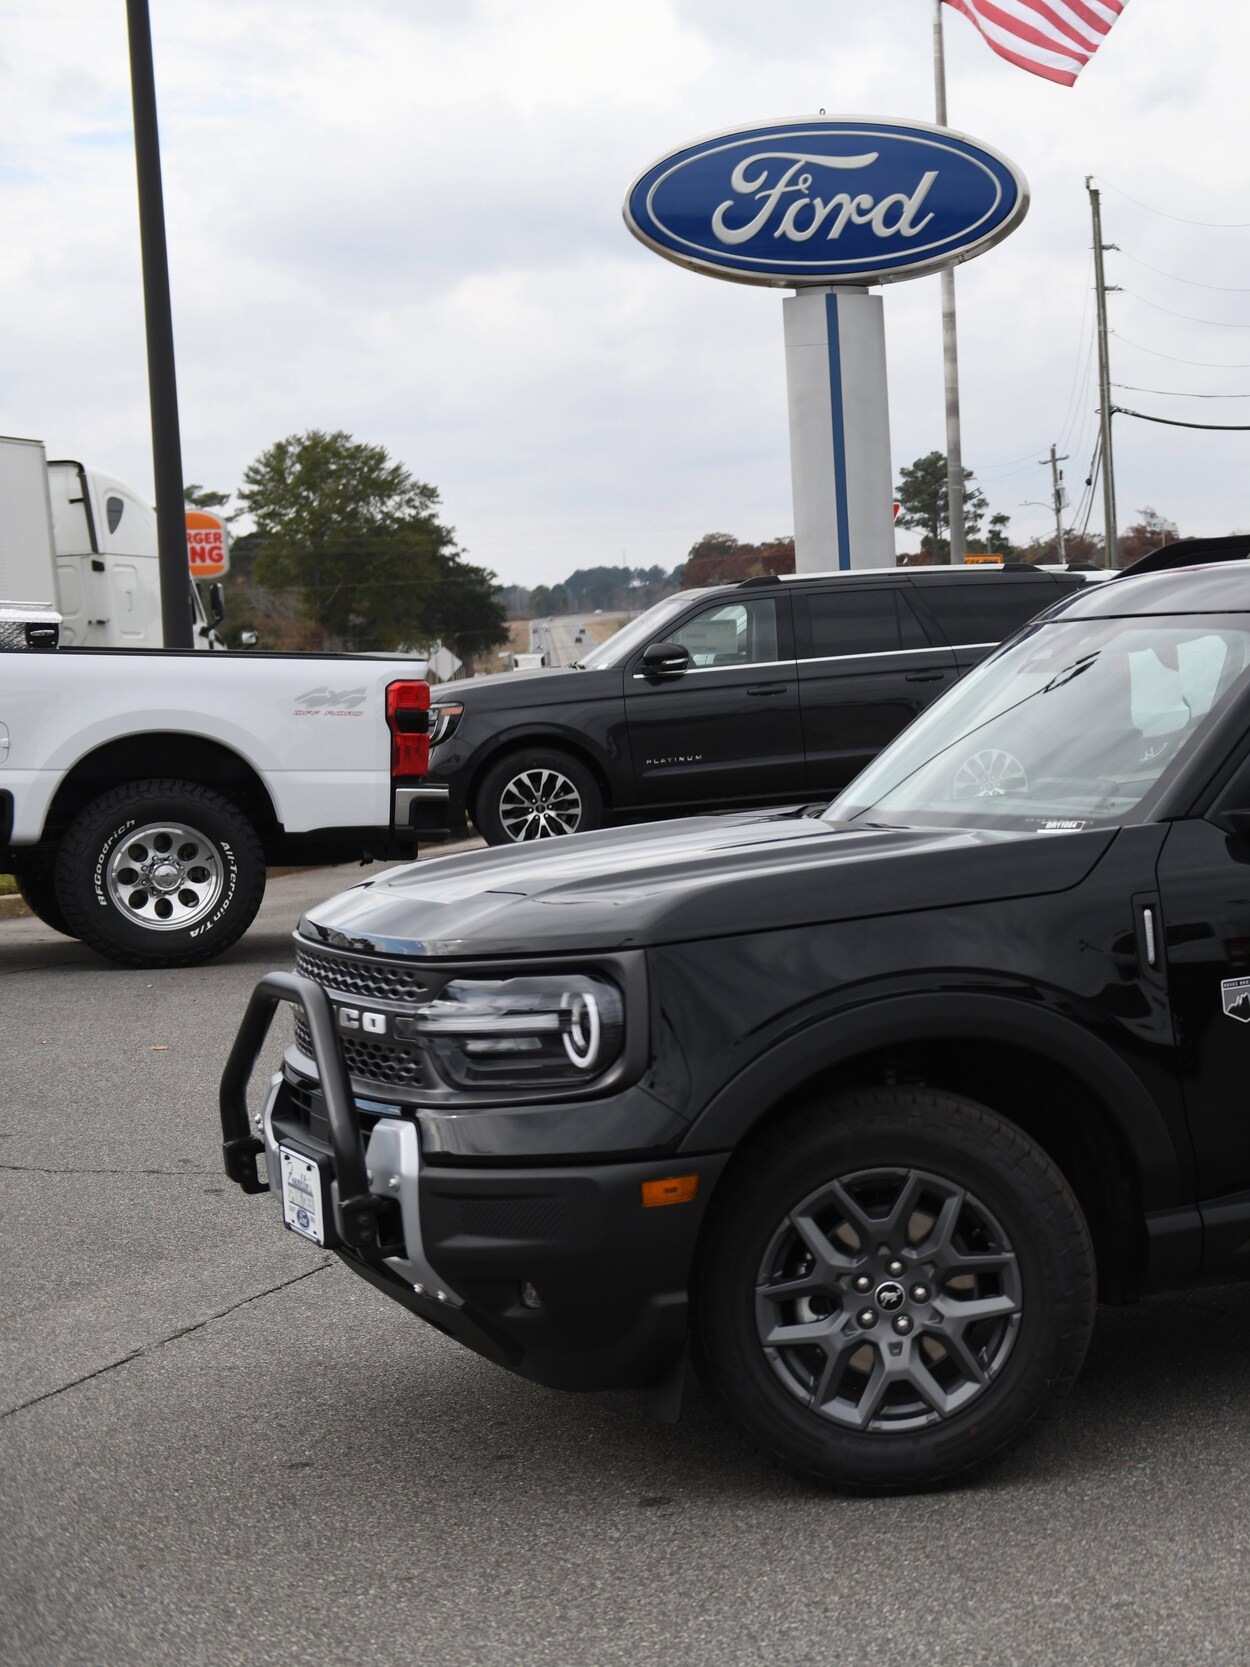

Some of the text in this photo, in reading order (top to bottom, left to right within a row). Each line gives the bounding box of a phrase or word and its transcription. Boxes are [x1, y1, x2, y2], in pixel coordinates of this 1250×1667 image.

[711, 151, 940, 246] Ford
[186, 531, 223, 545] RGER
[189, 545, 224, 564] NG
[293, 709, 364, 717] OFF ROAD
[645, 754, 703, 765] PLATINUM
[93, 819, 136, 906] BFGoodrich
[189, 840, 238, 939] All-Terrain T/A
